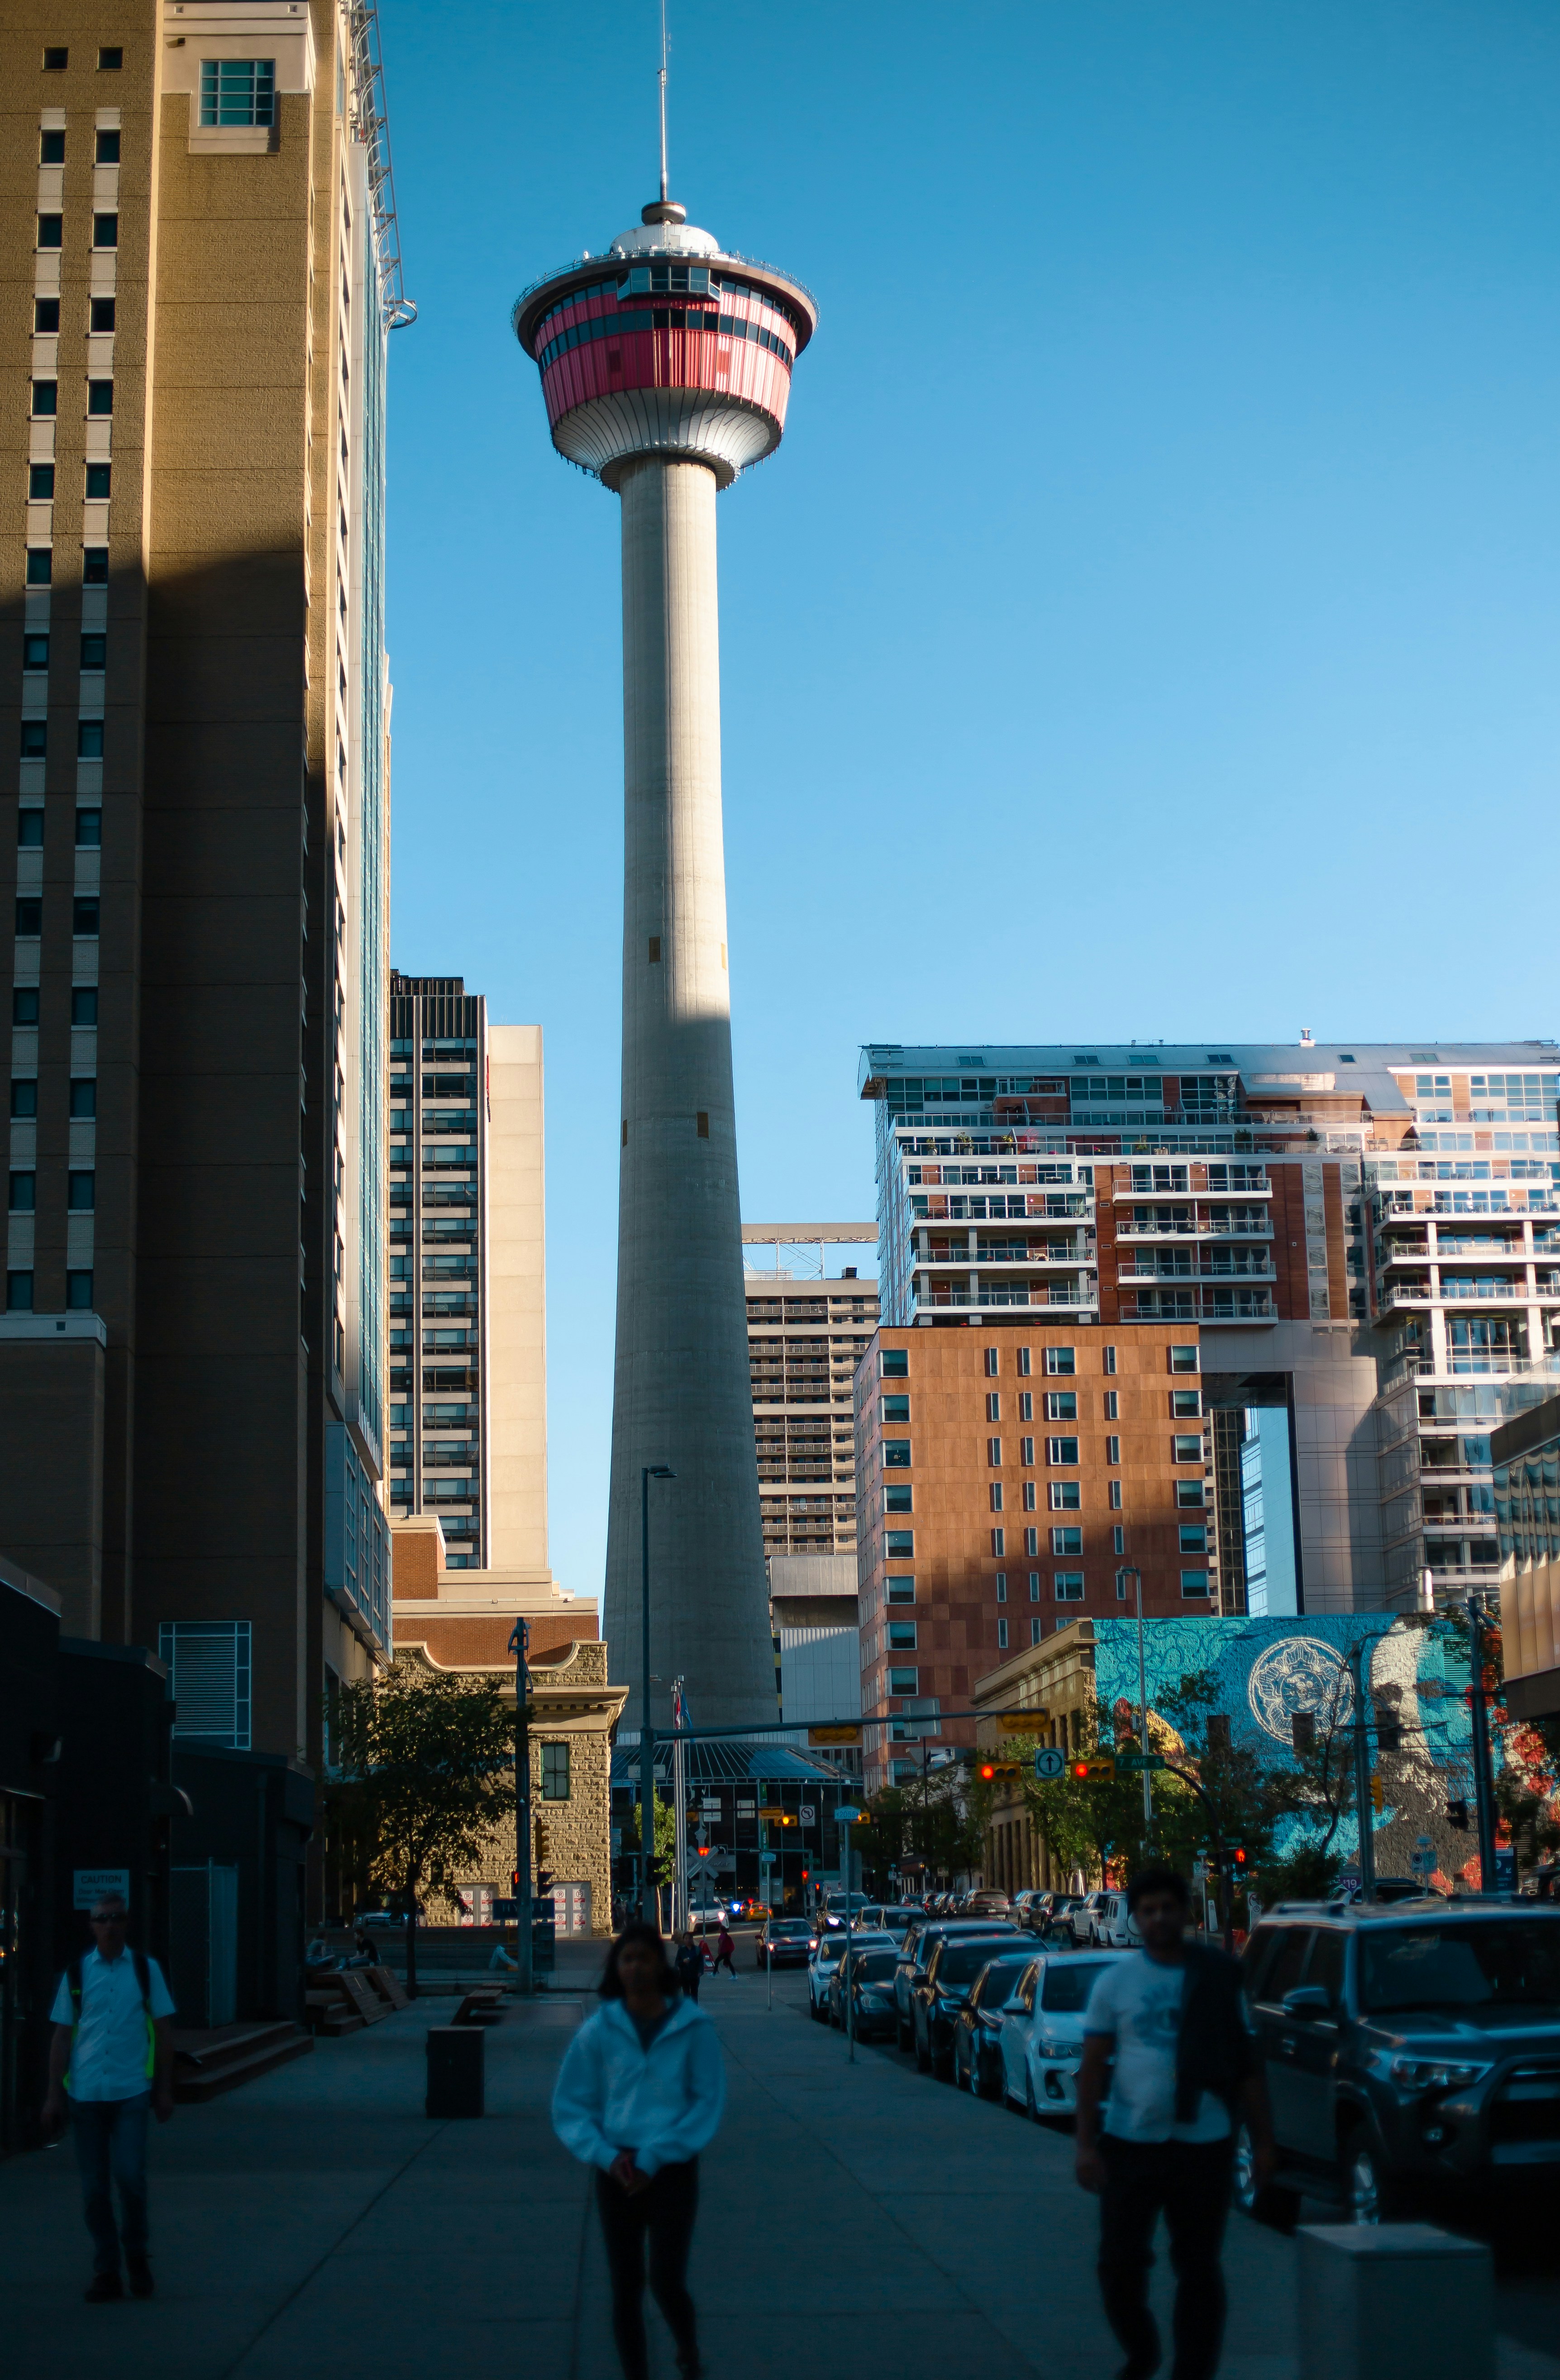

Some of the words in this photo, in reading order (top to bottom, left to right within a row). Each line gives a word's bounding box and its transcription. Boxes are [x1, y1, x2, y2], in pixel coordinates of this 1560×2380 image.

[1155, 1759, 1161, 1767] S
[81, 1875, 121, 1884] CAUTION
[1343, 1879, 1357, 1889] $19
